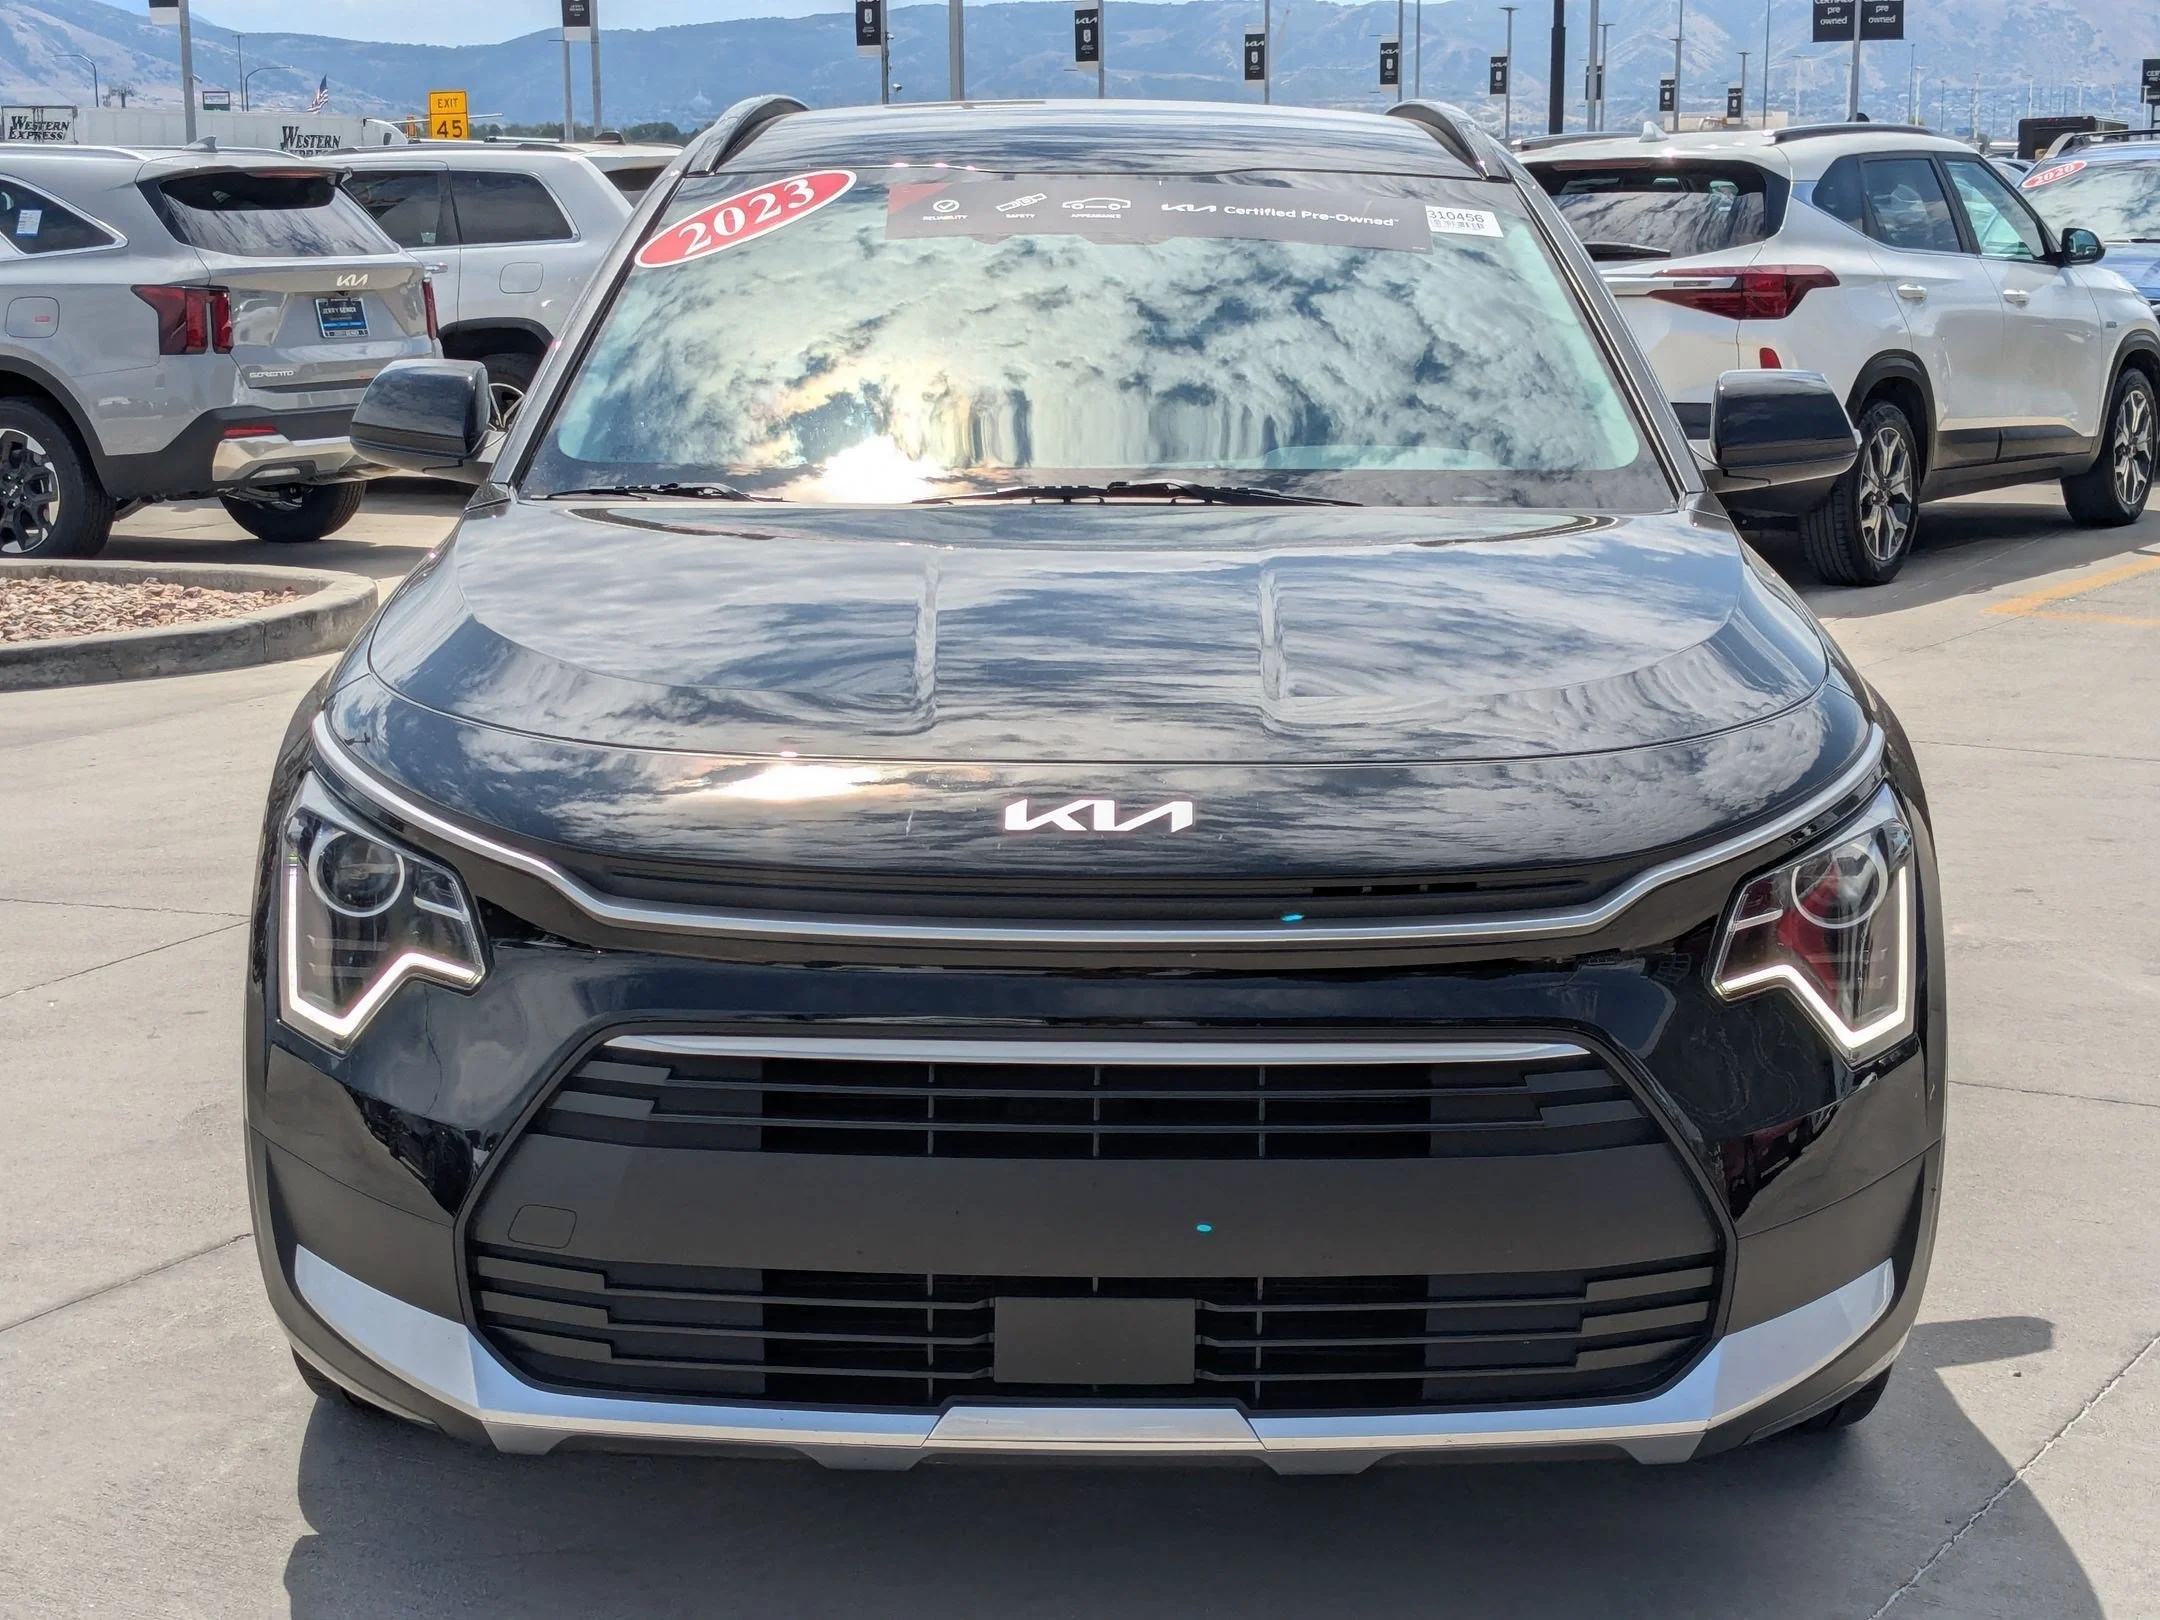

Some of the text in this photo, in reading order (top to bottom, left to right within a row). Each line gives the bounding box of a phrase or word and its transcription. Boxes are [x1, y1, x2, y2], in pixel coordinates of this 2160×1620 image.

[1827, 6, 1841, 15] pre
[1875, 5, 1889, 13] pre
[1075, 16, 1098, 25] KIA
[1820, 16, 1848, 25] owned
[1868, 15, 1896, 23] owned
[437, 98, 458, 109] EXIT
[436, 119, 463, 138] 45
[282, 126, 341, 149] WESTERN
[1161, 203, 1217, 213] KIA
[1224, 206, 1297, 218] Certified
[1426, 210, 1485, 223] 310456
[678, 178, 816, 256] 2023
[336, 273, 369, 287] KIA
[249, 370, 294, 379] SORENTO
[1004, 798, 1193, 833] KIA
